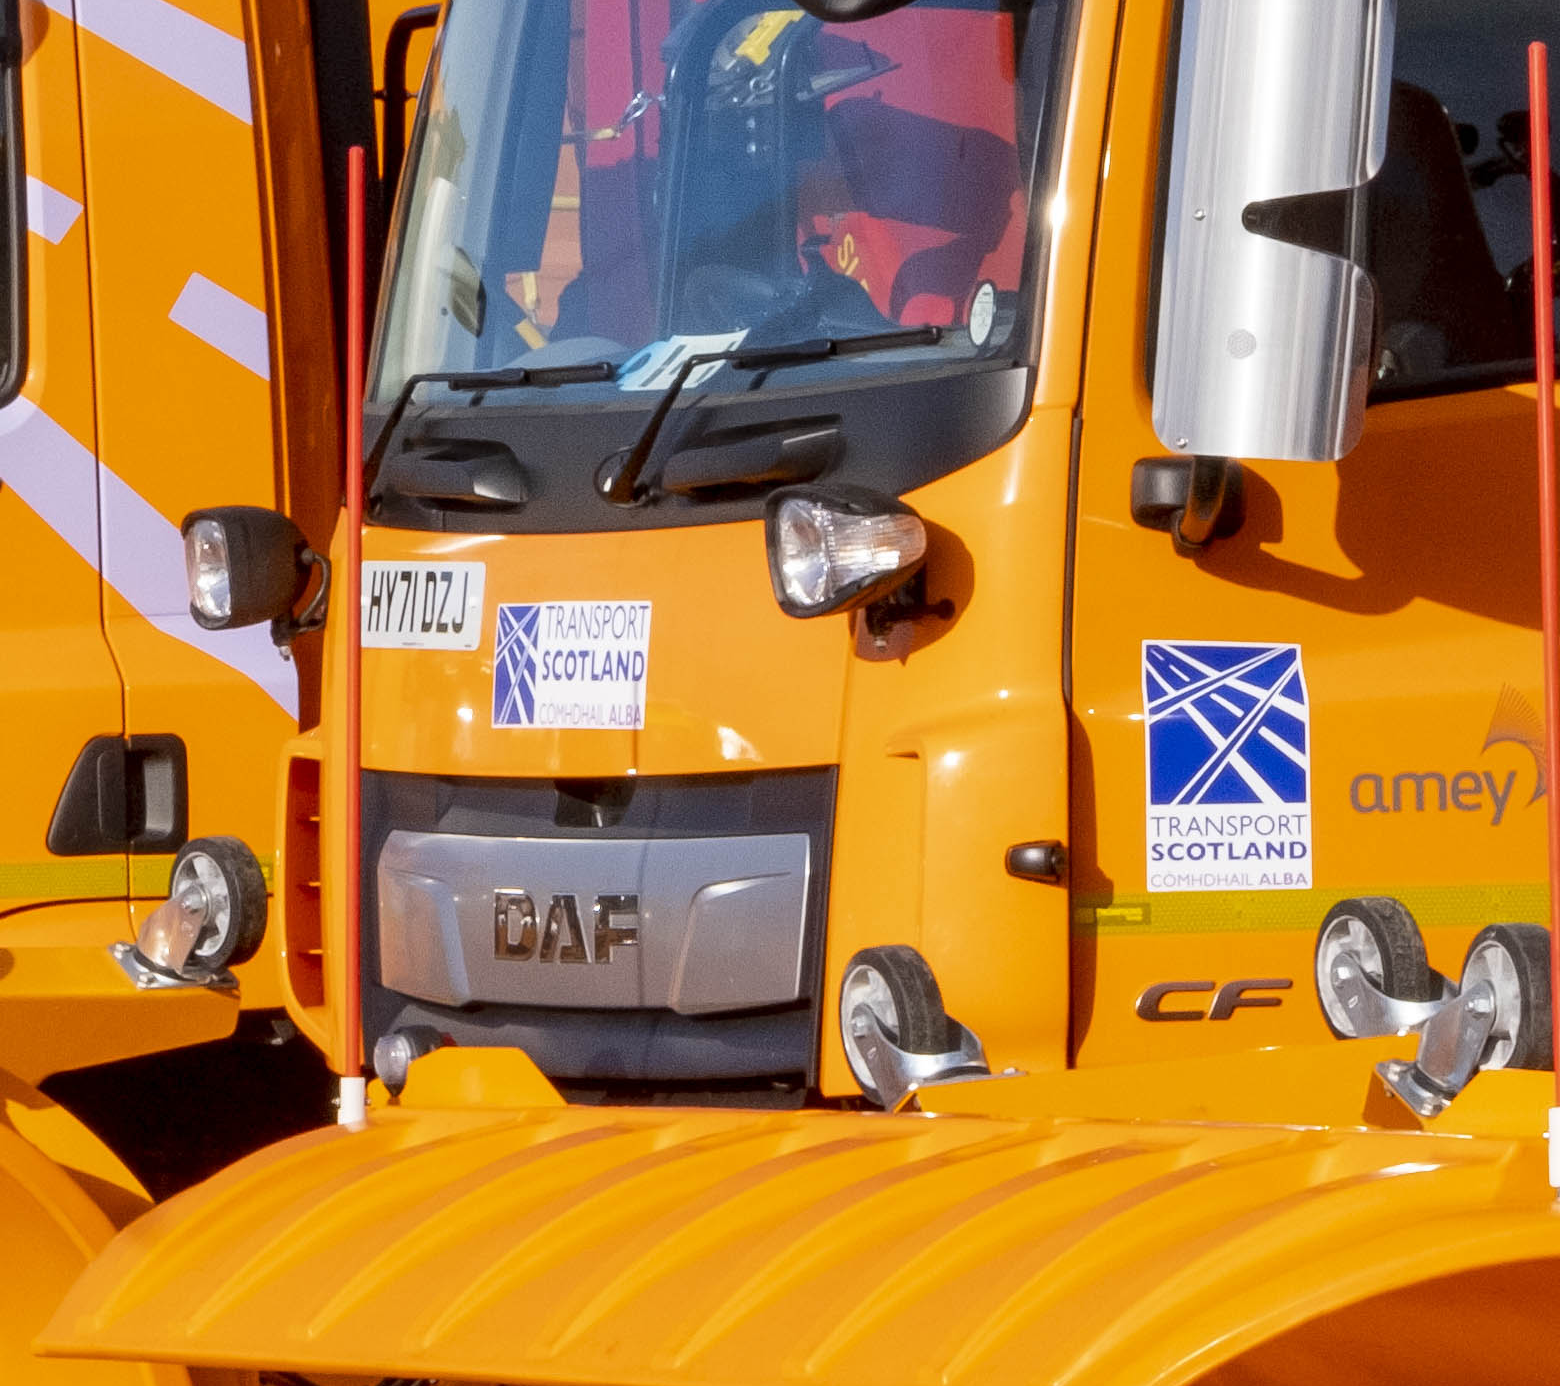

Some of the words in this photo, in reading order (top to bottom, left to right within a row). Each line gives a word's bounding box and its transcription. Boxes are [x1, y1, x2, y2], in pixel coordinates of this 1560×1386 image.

[367, 570, 418, 633] HY71
[420, 570, 469, 634] DZJ
[545, 604, 649, 641] TRANSPORT
[541, 650, 645, 682] SCOTLAND
[608, 703, 642, 726] ALBA
[1350, 771, 1517, 826] amey
[1150, 814, 1308, 838] TRANSPORT
[1151, 841, 1308, 861] SCOTLAND
[1259, 873, 1308, 886] ALBA
[493, 886, 641, 965] DAF
[1135, 977, 1294, 1023] CF
